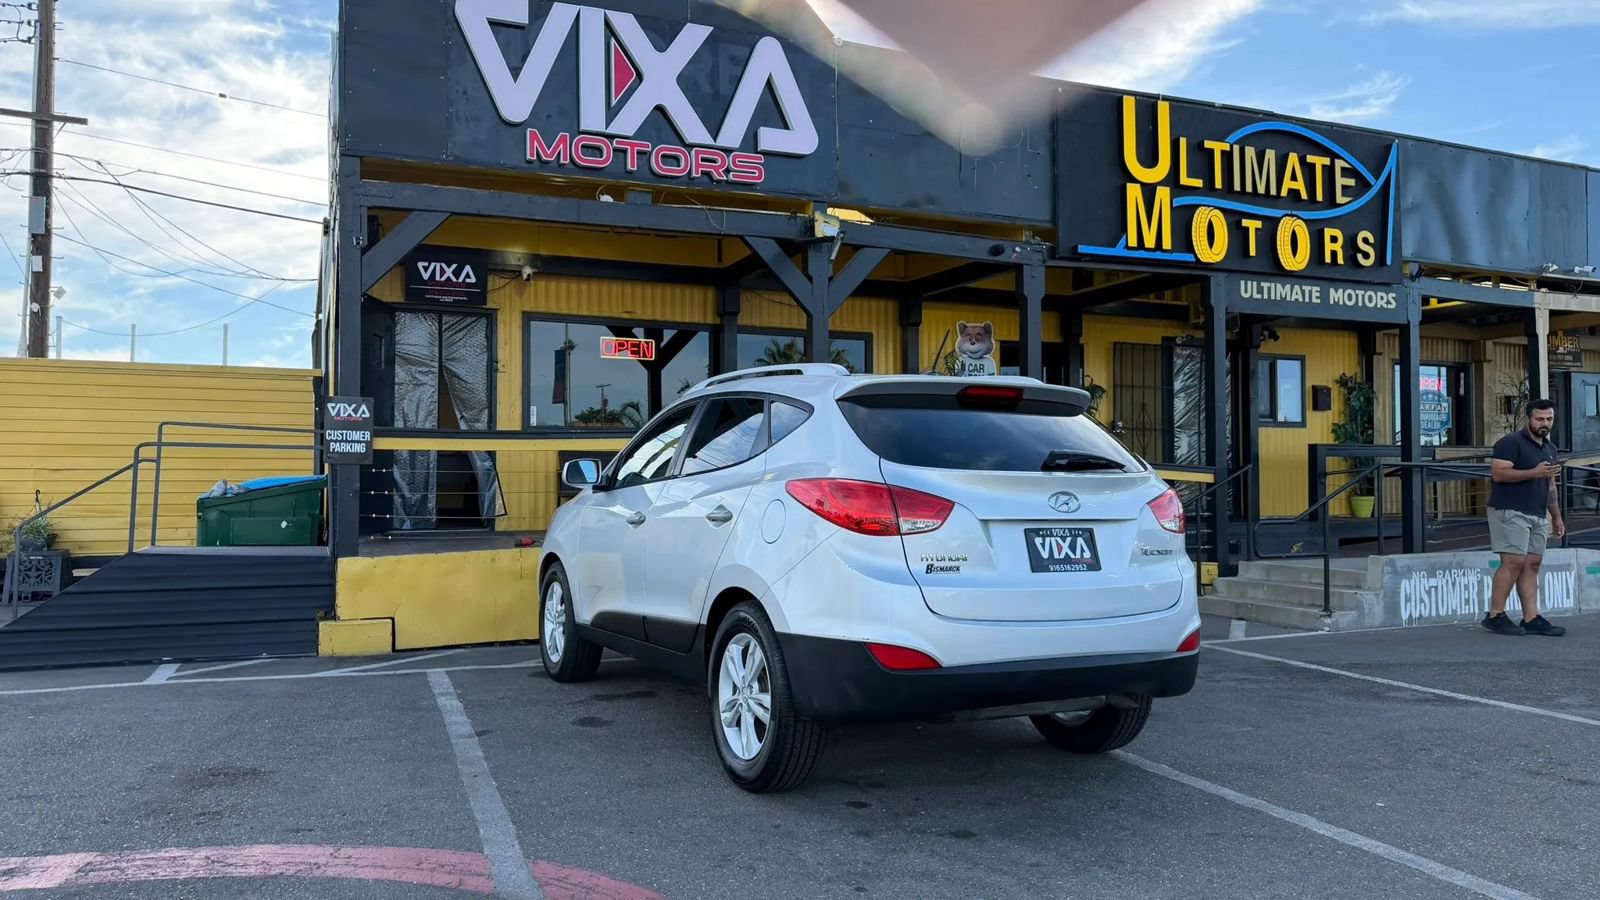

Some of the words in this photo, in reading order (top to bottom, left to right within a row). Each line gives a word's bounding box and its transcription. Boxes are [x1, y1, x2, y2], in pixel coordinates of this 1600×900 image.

[455, 0, 819, 155] VIXA
[526, 127, 765, 184] MOTORS
[1122, 95, 1358, 205] ULTIMATE
[1125, 182, 1376, 272] MOTORS
[417, 261, 476, 283] VIXA
[1240, 280, 1321, 303] ULTIMATE
[1329, 287, 1397, 309] MOTORS
[602, 339, 653, 358] OPEN
[968, 363, 985, 373] CAR
[1420, 377, 1443, 392] PEN
[327, 402, 370, 418] VIXA
[326, 430, 371, 441] CUSTOMER
[330, 442, 366, 453] PARKING
[1052, 528, 1070, 536] VIXA
[920, 553, 968, 562] HYUNDAI
[1034, 537, 1091, 559] VIXA
[925, 563, 962, 574] BISMARCK
[1400, 576, 1479, 618] CUSTOMER
[1545, 570, 1576, 609] ONLY
